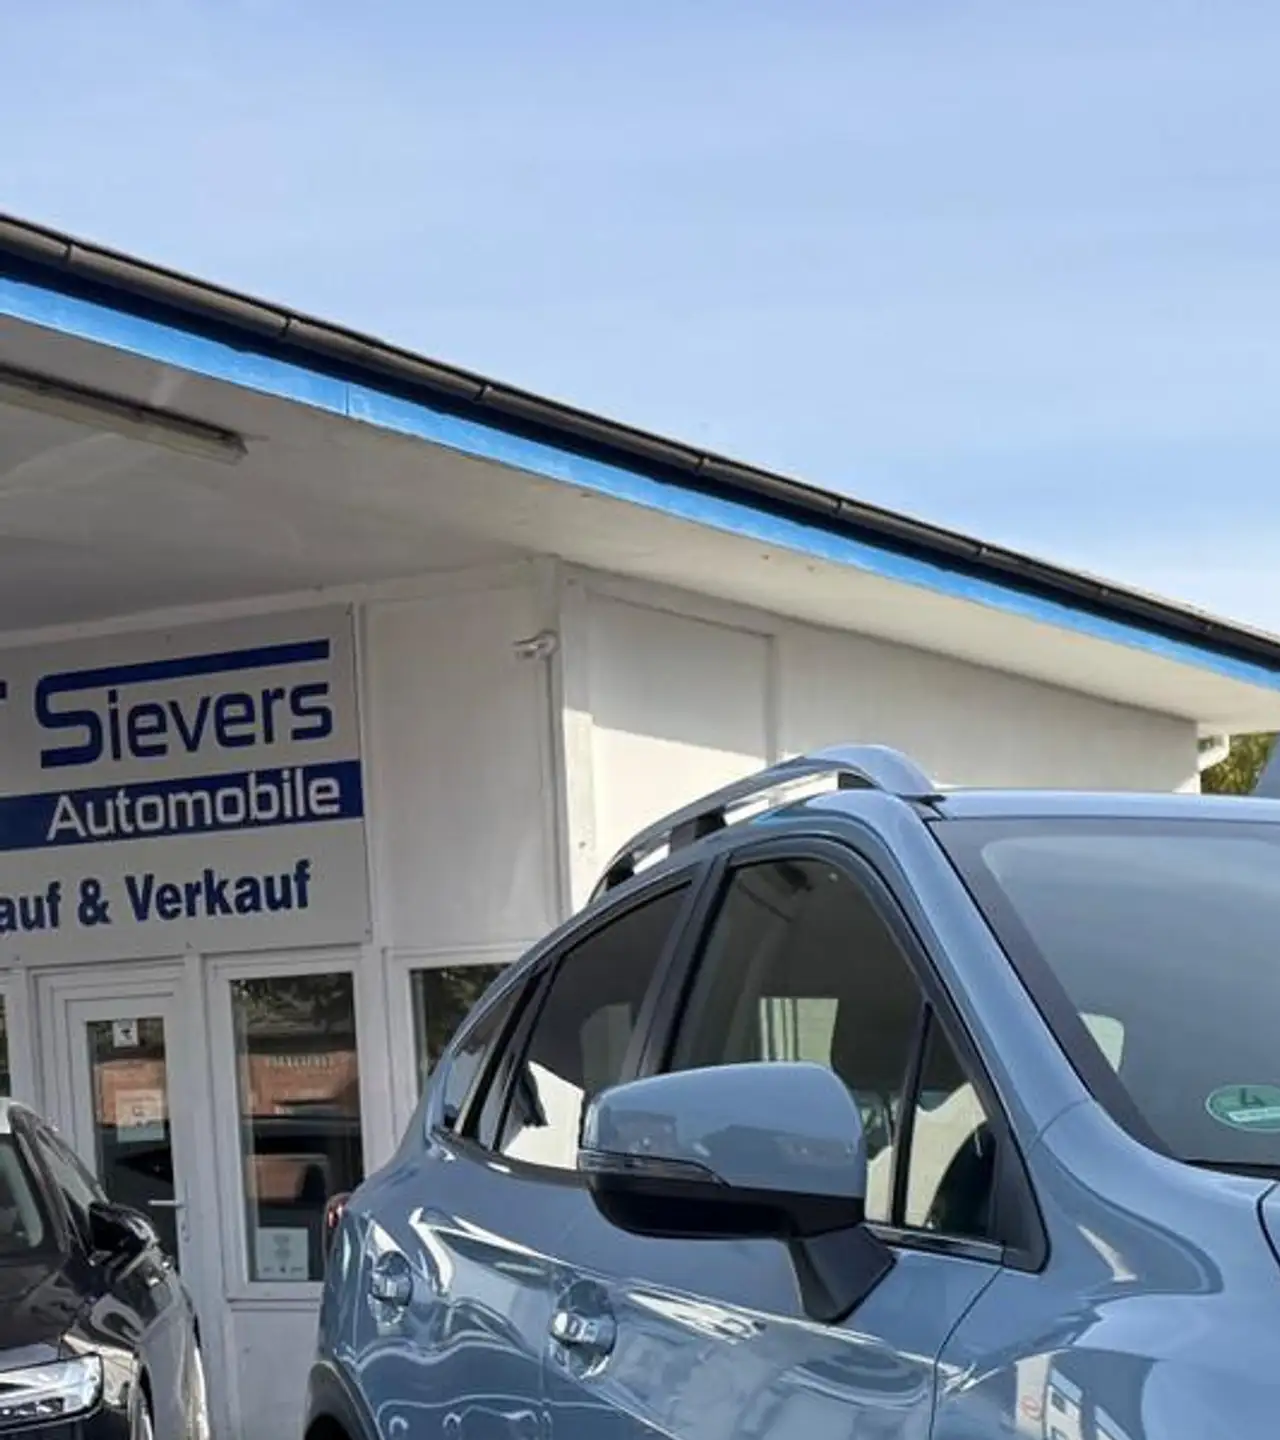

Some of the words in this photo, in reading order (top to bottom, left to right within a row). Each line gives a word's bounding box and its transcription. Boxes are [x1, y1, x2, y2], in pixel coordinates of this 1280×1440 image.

[35, 638, 333, 769] Sievers
[46, 768, 341, 841] Automobile
[78, 878, 112, 926] &
[125, 858, 311, 922] Verkauf
